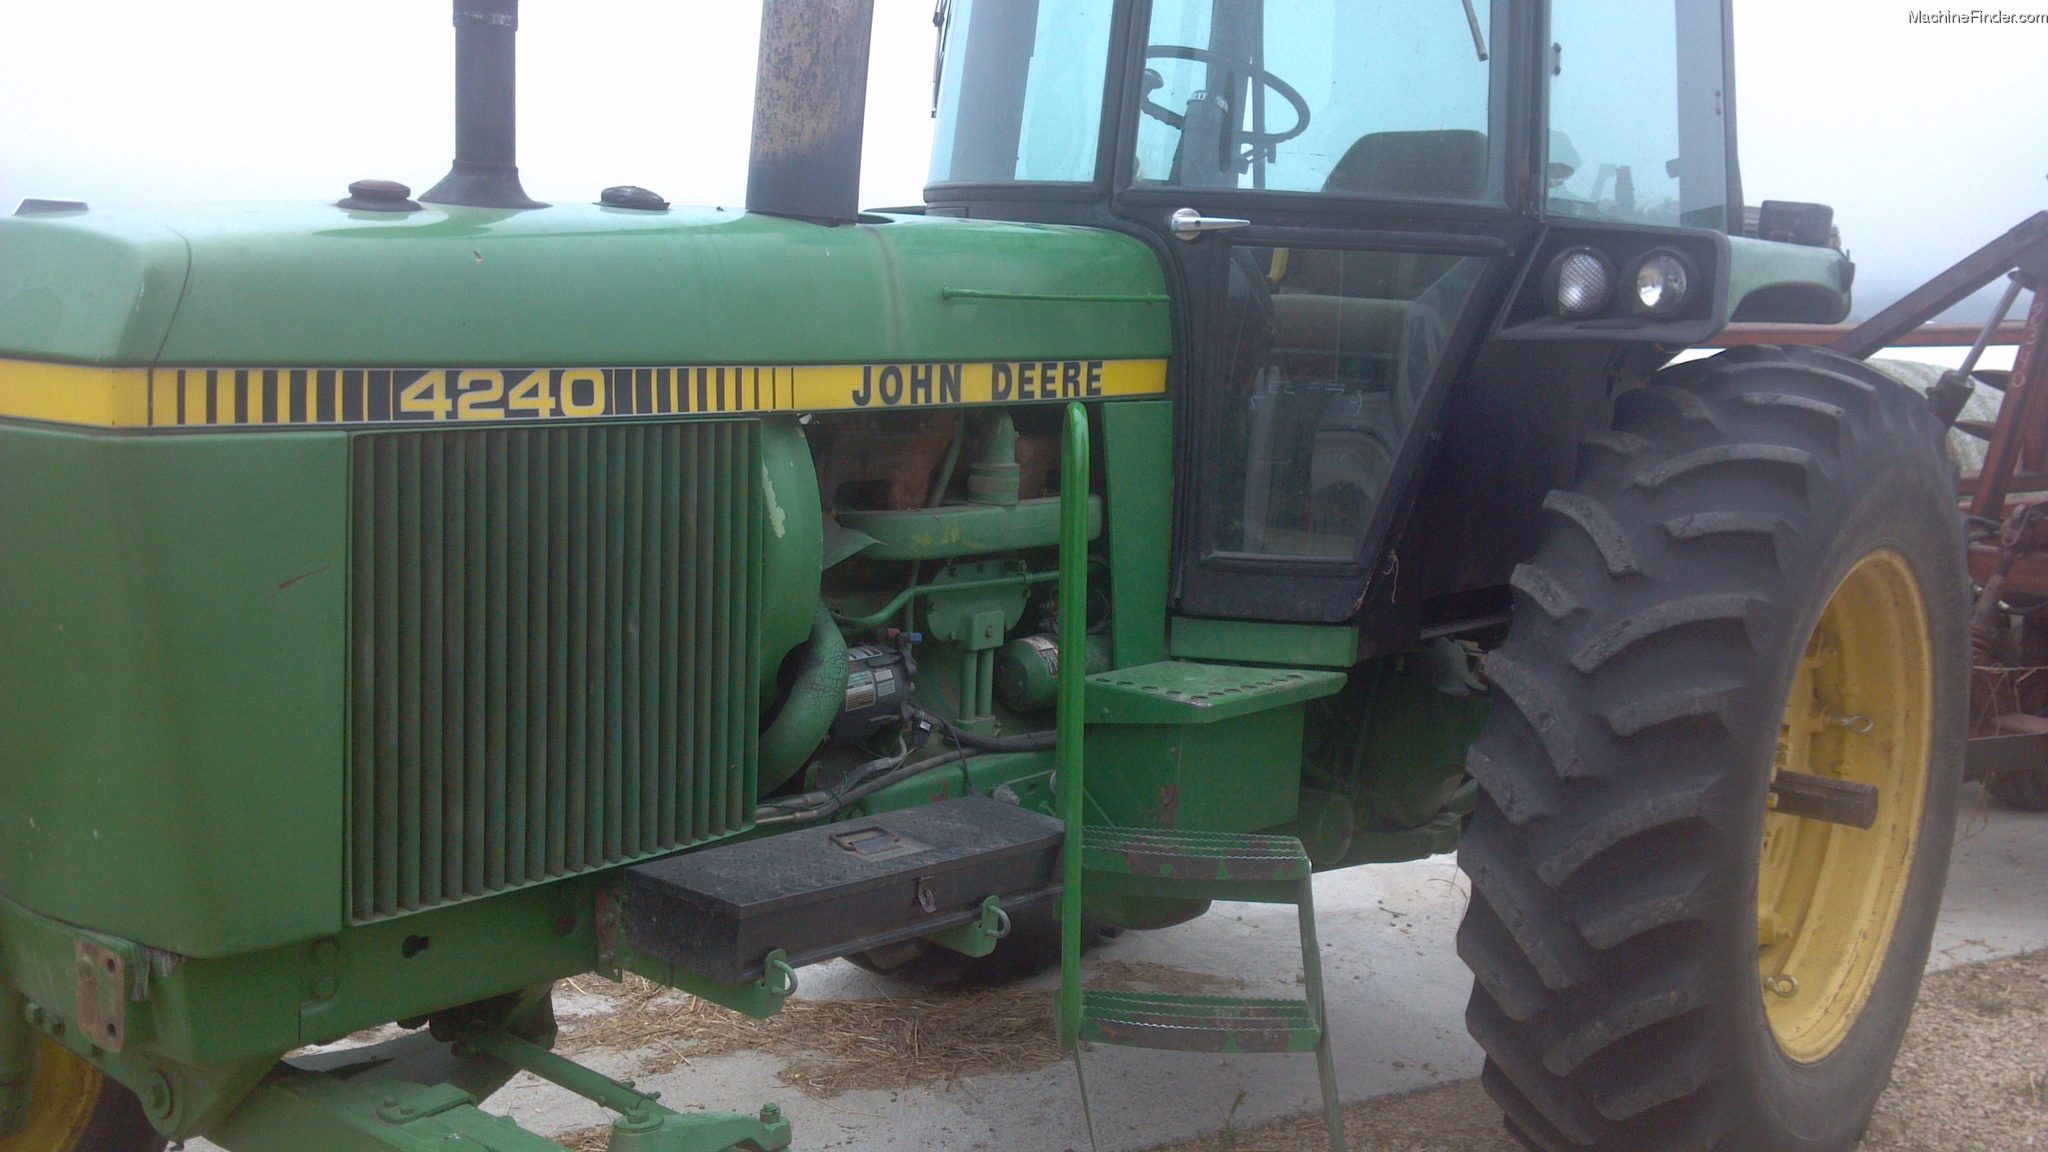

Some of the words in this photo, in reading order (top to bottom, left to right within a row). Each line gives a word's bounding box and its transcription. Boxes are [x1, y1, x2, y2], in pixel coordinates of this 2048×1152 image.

[400, 368, 606, 422] 4240
[852, 364, 963, 407] JOHN
[991, 361, 1103, 401] DEERE
